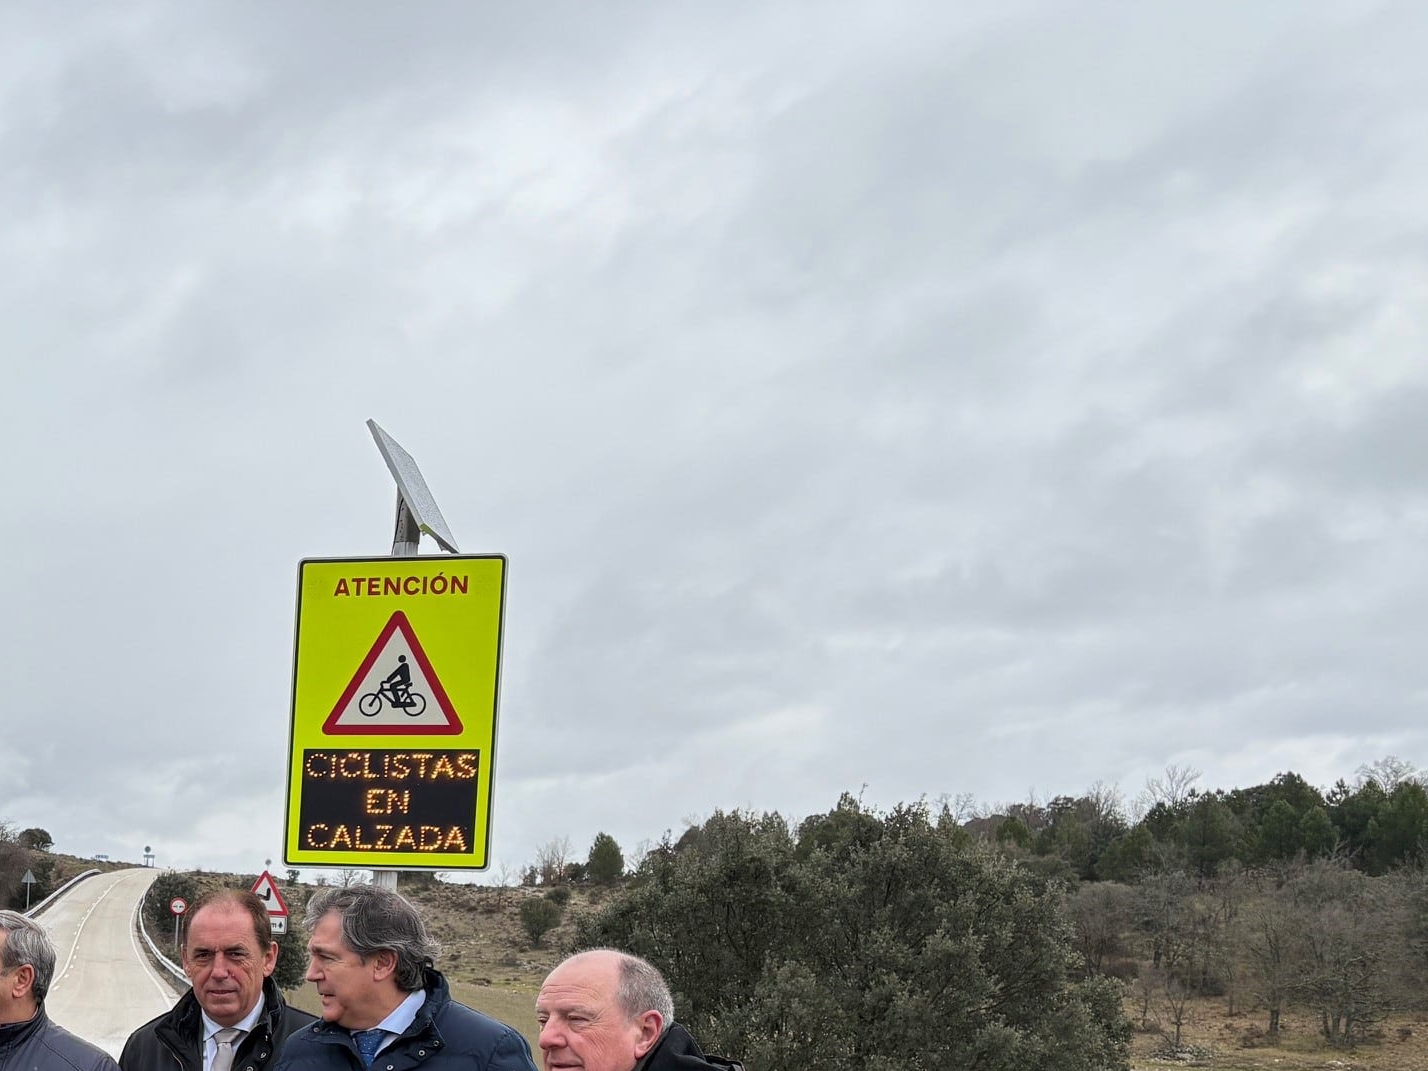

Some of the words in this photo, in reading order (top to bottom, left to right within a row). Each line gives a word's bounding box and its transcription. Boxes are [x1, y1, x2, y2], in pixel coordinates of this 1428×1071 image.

[334, 572, 469, 597] ATENCIÓN
[306, 753, 477, 779] CICLISTAS
[366, 789, 410, 814] EN
[307, 823, 468, 852] CALZADA
